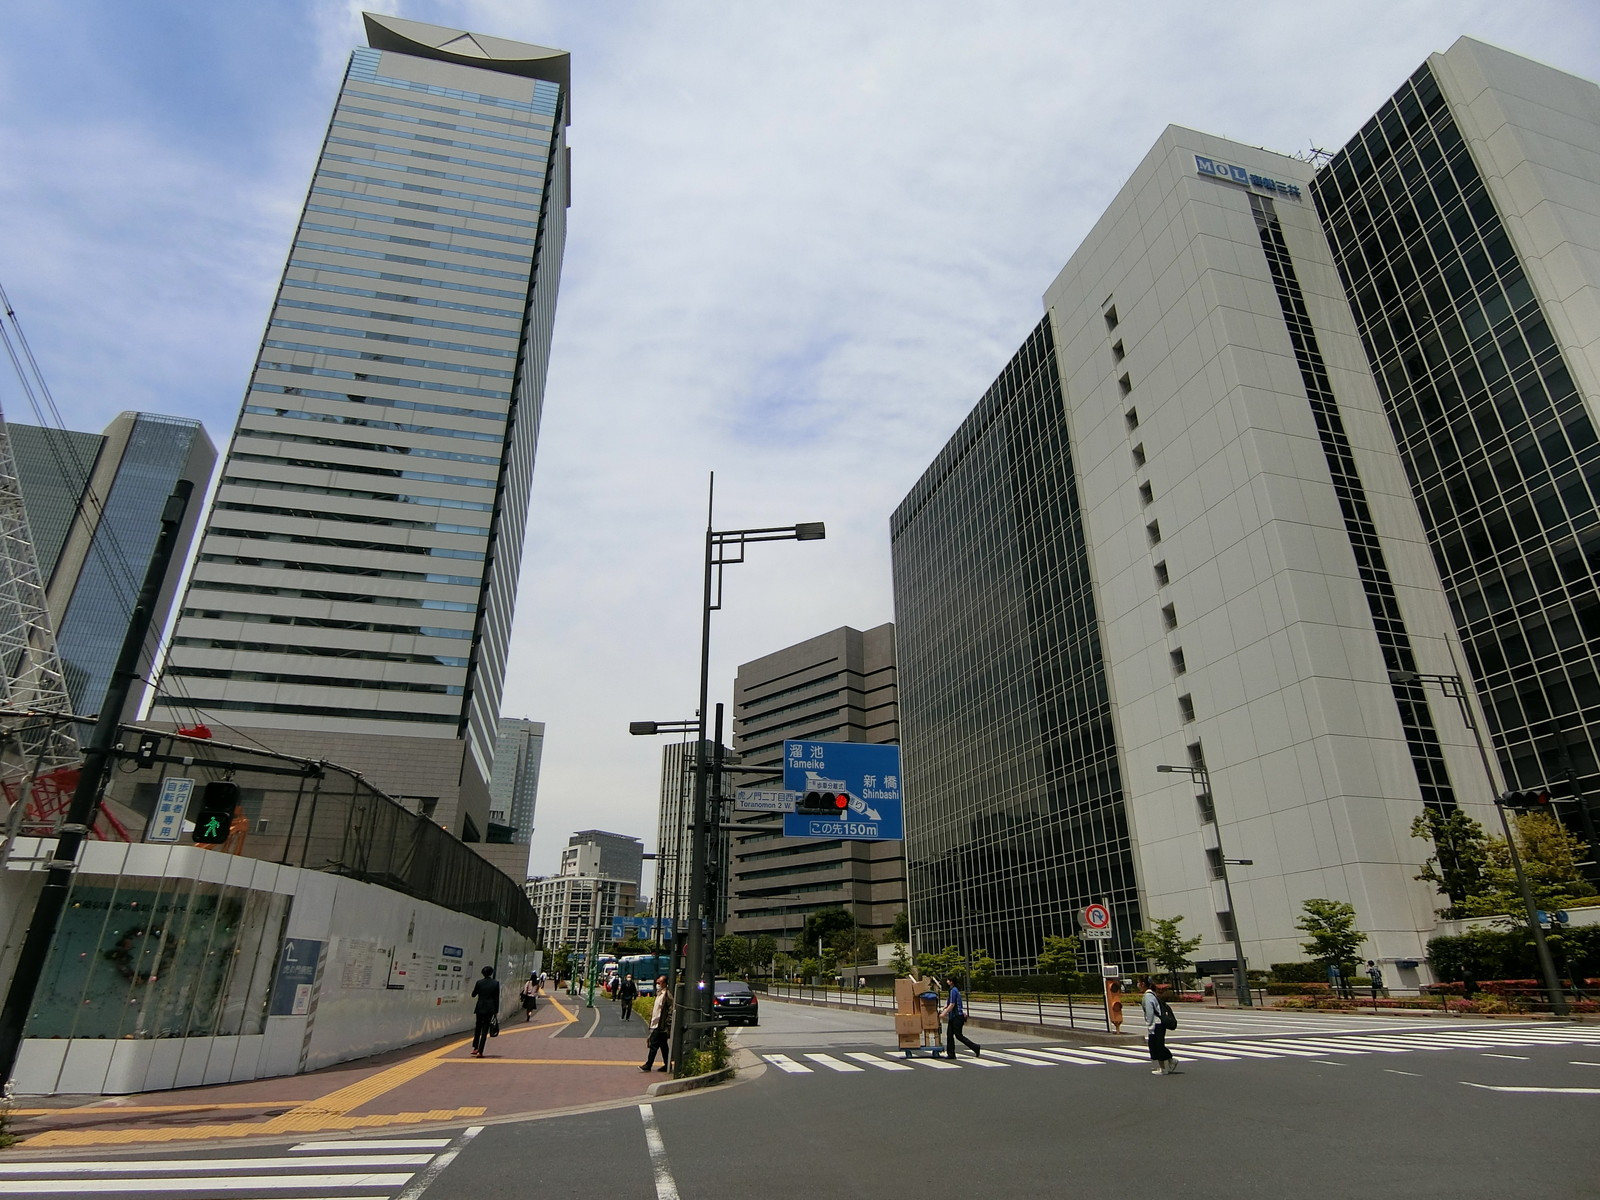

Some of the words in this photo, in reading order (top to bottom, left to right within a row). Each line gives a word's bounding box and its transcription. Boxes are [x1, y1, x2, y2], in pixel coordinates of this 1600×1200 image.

[1197, 158, 1248, 182] MOL
[789, 744, 824, 758] 溜池
[788, 758, 825, 769] Tameike
[863, 774, 898, 789] 新橋
[737, 791, 794, 802] 虎ノ門二丁目西
[862, 789, 899, 800] Shinbashi
[740, 801, 776, 809] Toranomon
[811, 823, 877, 835] この先150m
